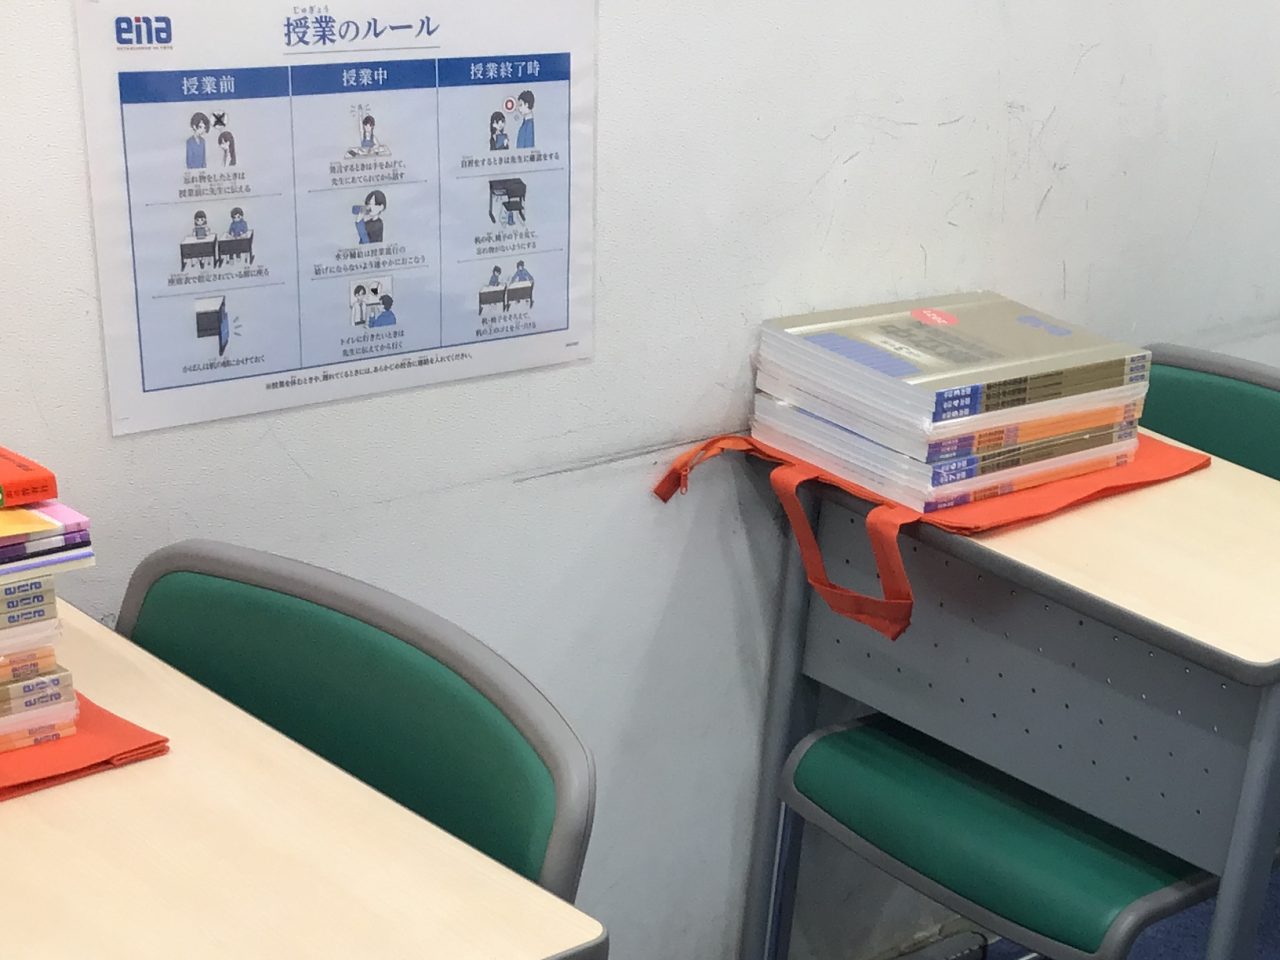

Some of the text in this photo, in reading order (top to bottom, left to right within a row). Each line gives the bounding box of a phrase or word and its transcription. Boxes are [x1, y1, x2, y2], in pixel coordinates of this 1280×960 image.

[115, 16, 172, 45] ena
[284, 15, 440, 47] 授業のルール
[342, 67, 388, 87] 授業中
[470, 60, 540, 80] 授業終了時
[182, 75, 235, 95] 授業前
